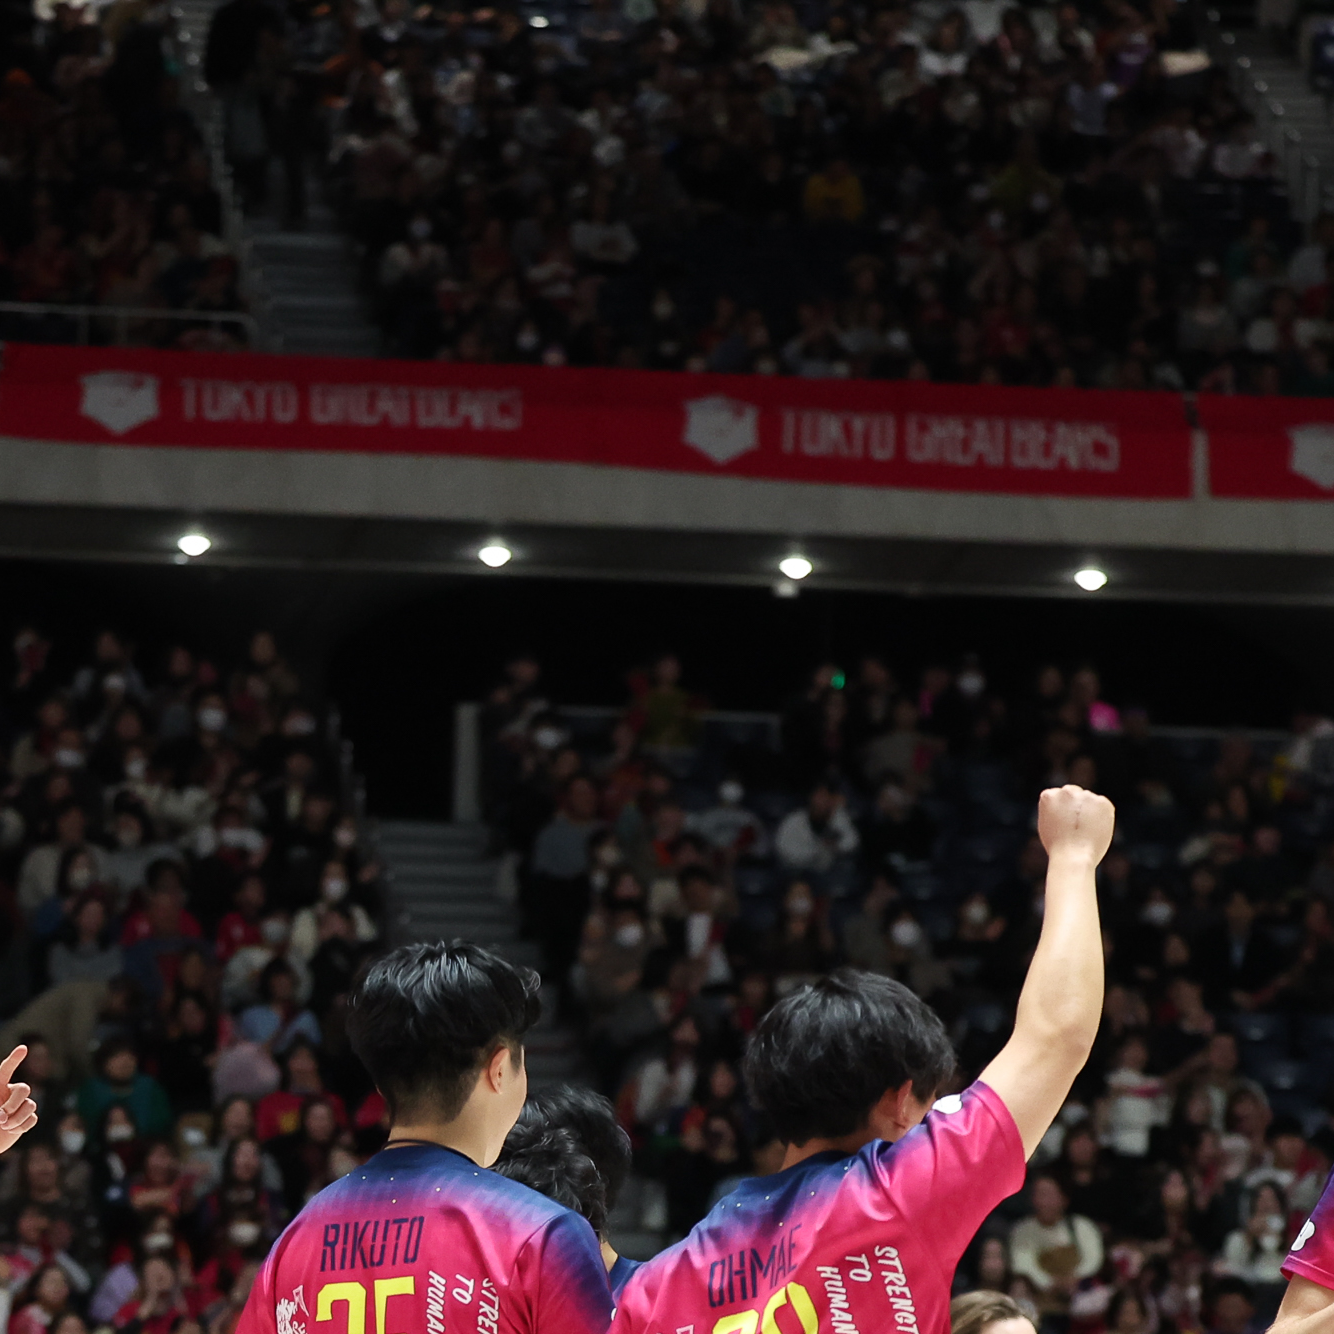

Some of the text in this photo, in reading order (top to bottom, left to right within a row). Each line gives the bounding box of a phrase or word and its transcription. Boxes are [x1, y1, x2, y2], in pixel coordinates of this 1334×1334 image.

[179, 376, 298, 424] TOKYO
[779, 406, 896, 461] TOKYO
[320, 1216, 424, 1272] RIKUTO
[708, 1224, 802, 1308] OHMAE
[845, 1254, 872, 1282] TO
[452, 1273, 474, 1305] TO
